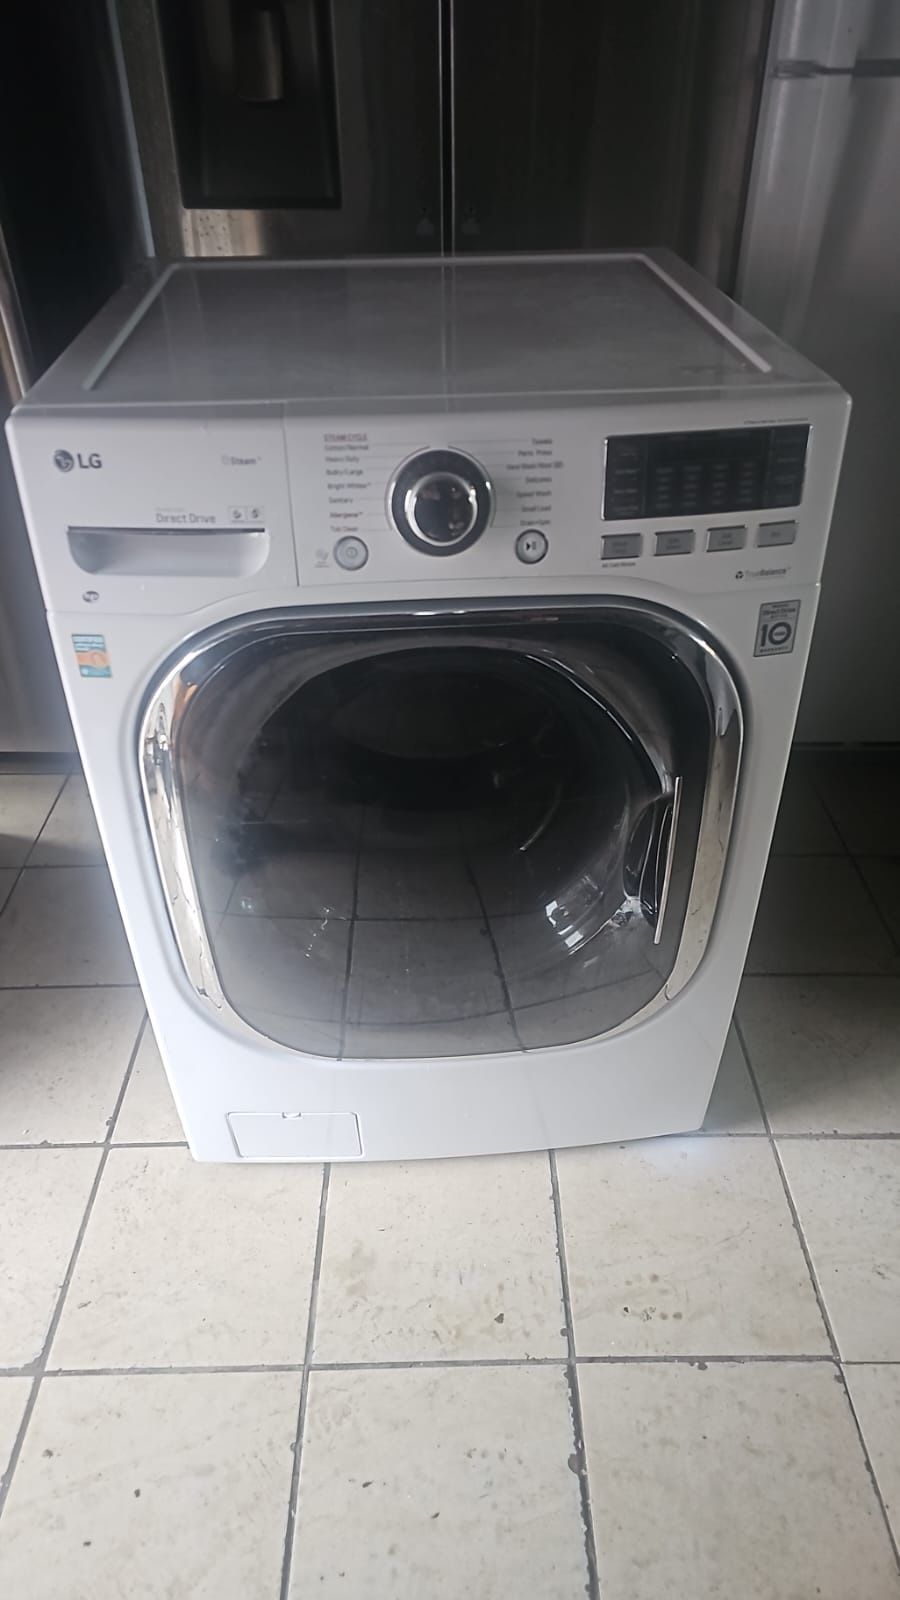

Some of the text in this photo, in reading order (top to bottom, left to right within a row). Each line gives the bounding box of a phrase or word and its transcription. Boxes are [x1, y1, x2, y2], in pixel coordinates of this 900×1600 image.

[77, 453, 103, 469] LG
[156, 513, 187, 524] Direct
[189, 513, 217, 524] Drive
